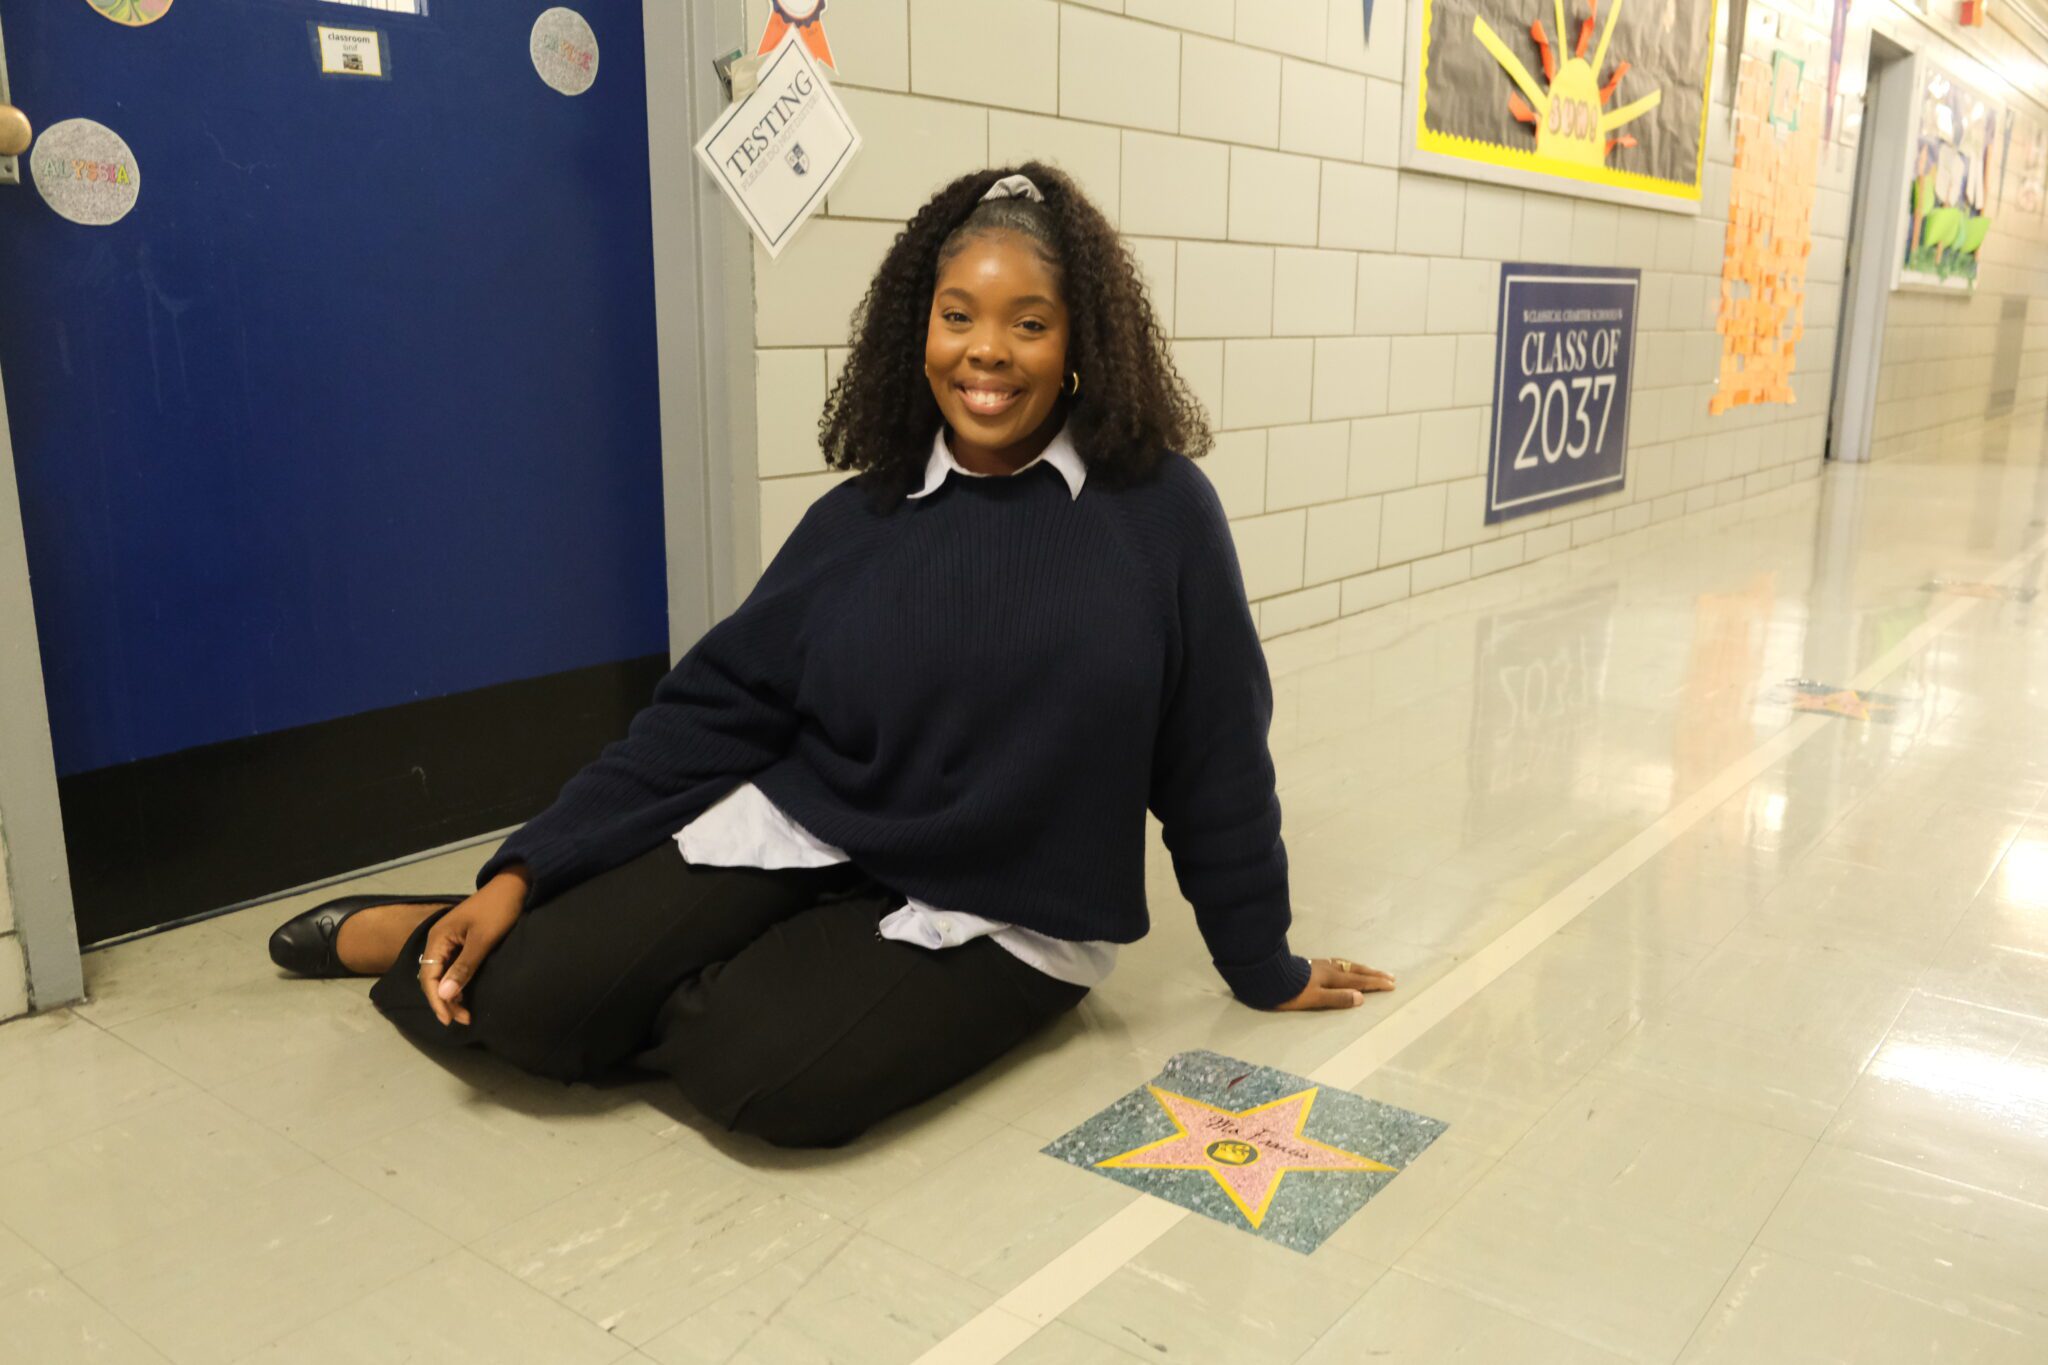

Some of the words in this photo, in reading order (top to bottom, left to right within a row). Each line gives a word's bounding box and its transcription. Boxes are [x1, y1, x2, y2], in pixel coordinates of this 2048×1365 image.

[327, 33, 371, 44] classroom
[726, 69, 813, 177] TESTING
[1520, 329, 1588, 376] CLASS
[1591, 328, 1621, 369] OF
[1514, 374, 1617, 470] 2037
